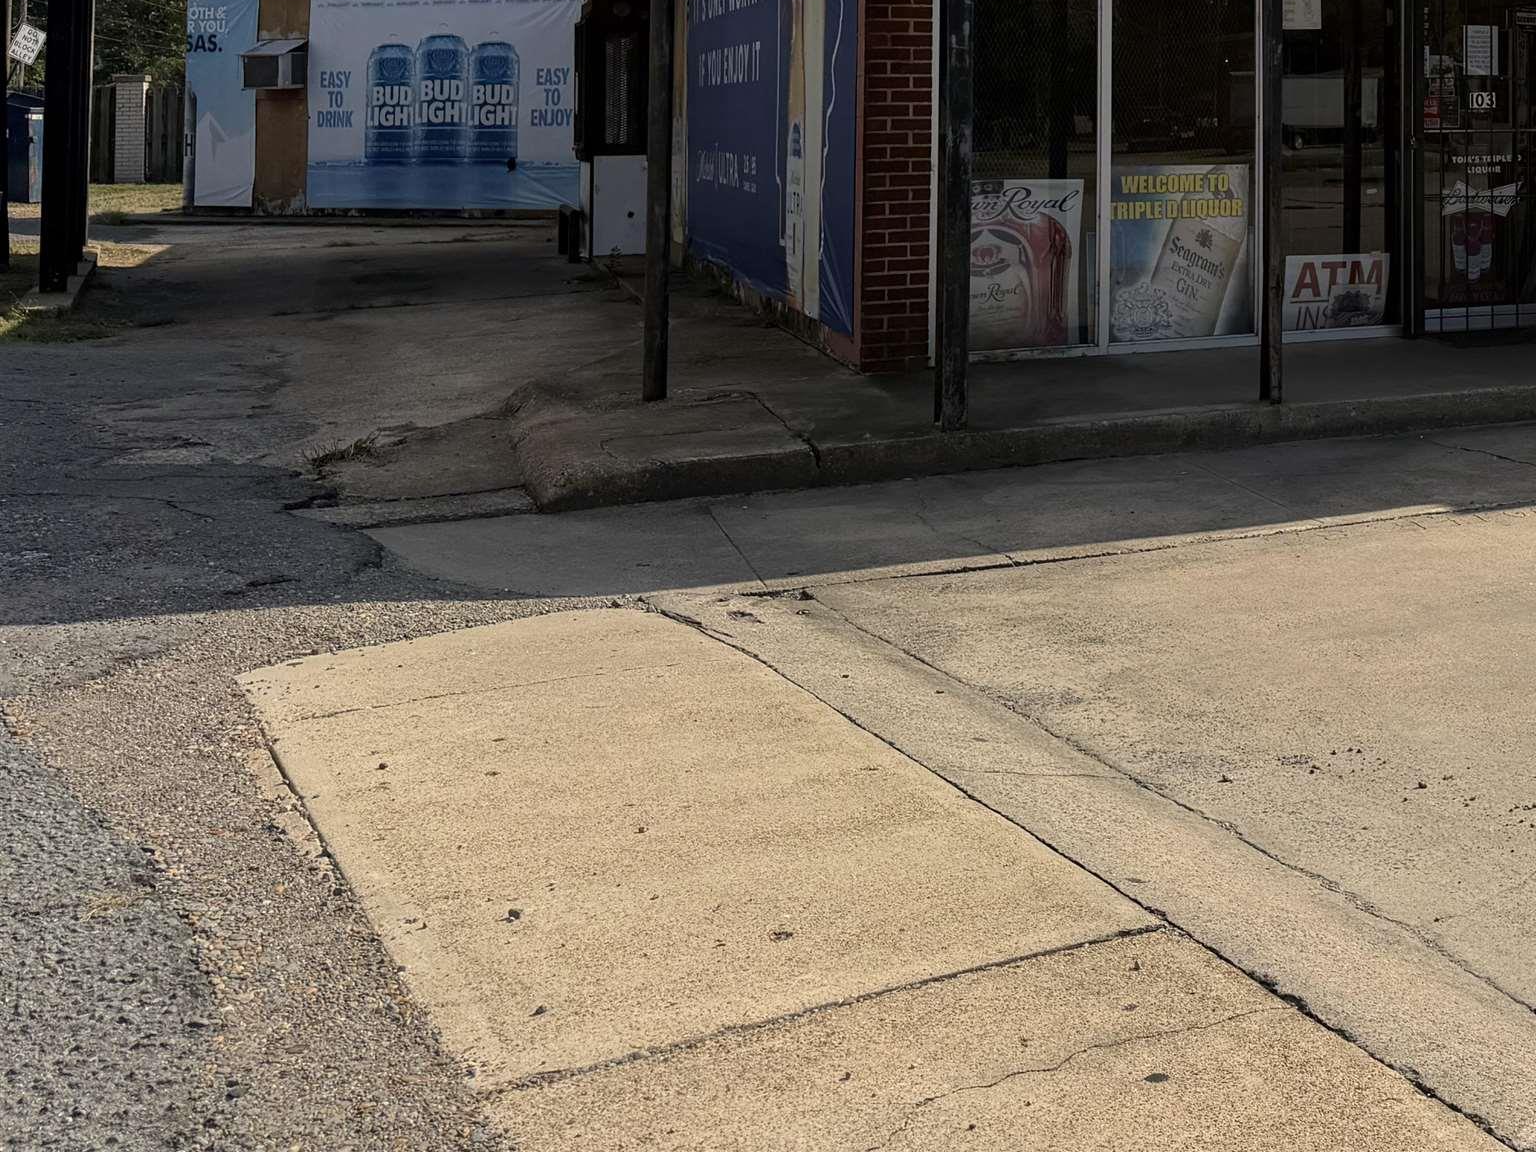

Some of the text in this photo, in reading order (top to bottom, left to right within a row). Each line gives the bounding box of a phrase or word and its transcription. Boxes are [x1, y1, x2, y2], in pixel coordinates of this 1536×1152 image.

[707, 48, 722, 86] YOU
[724, 43, 749, 84] ENJOY
[752, 41, 760, 82] IT
[319, 71, 352, 89] EASY
[536, 68, 570, 86] EASY
[327, 91, 343, 108] TO
[372, 86, 412, 106] BUD
[421, 79, 465, 101] BUD
[472, 84, 514, 105] BUD
[545, 88, 560, 106] TO
[317, 110, 353, 128] DRINK
[531, 108, 573, 127] ENJOY
[1121, 173, 1230, 194] WELCOME TO
[1000, 186, 1080, 221] Royal
[1110, 198, 1244, 220] TRIPLE D LIQUOR
[1170, 236, 1226, 280] Seagram's
[1292, 260, 1383, 298] ATM
[1296, 306, 1331, 330] INS
